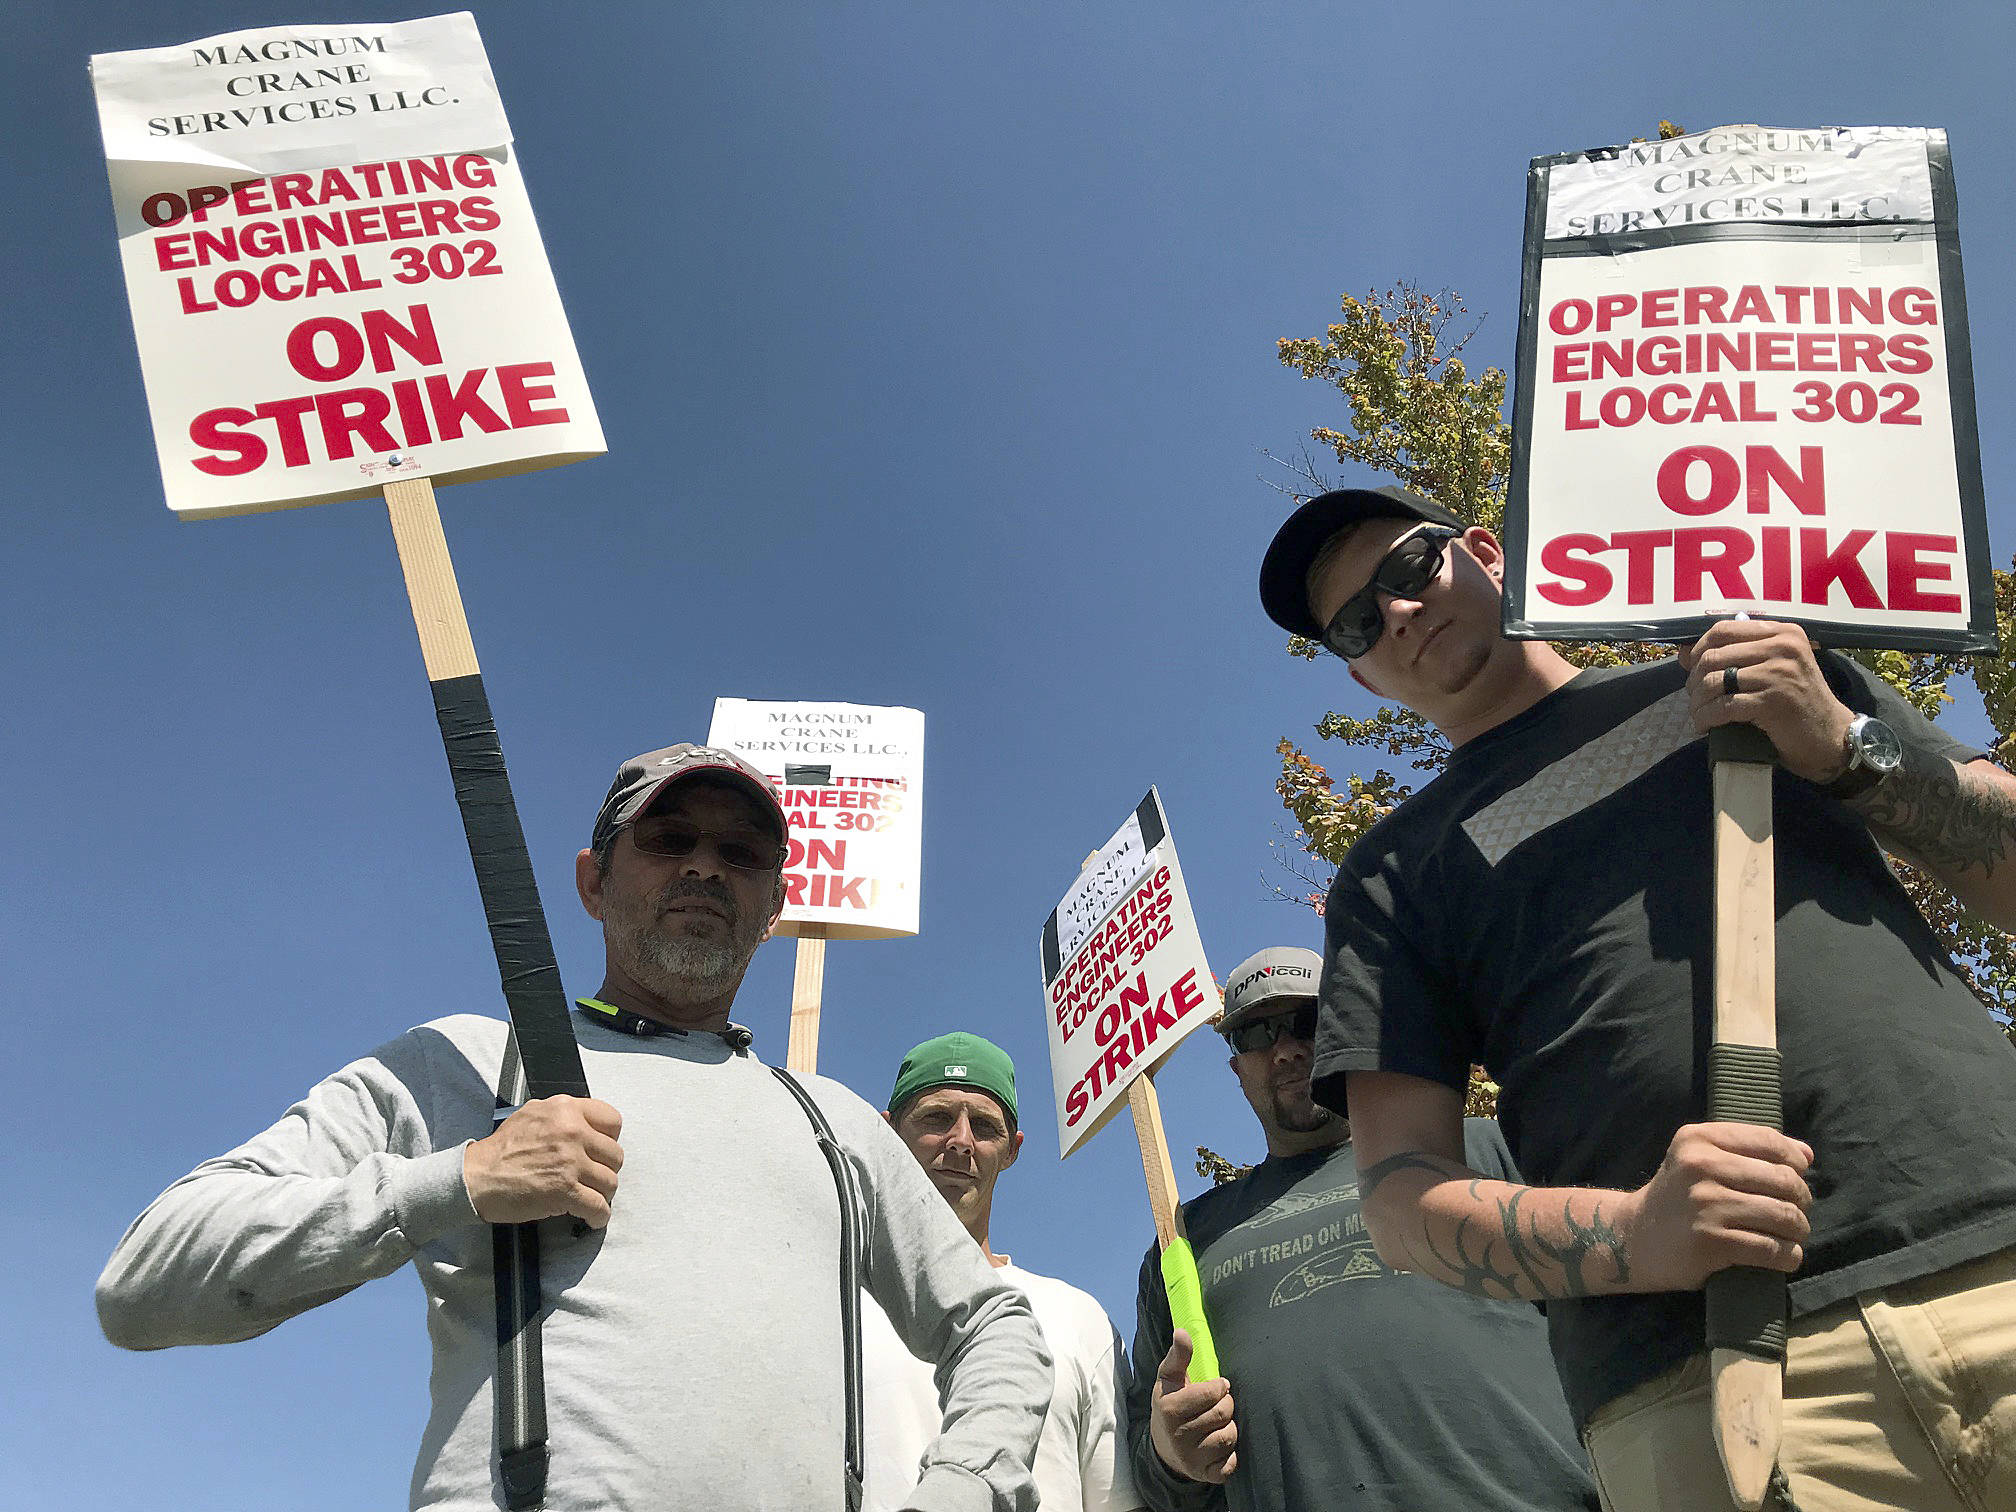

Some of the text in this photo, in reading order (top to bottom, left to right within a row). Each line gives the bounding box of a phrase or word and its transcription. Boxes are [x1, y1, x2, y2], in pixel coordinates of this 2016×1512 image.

[193, 36, 385, 67] MAGNUM
[227, 64, 370, 96] CRANE
[149, 86, 460, 136] SERVICES LLC.
[1627, 132, 1834, 167] MAGNUM
[1654, 164, 1808, 194] CRANE
[142, 154, 497, 228] OPERATING
[1568, 197, 1900, 237] SERVICES LLC.
[154, 196, 501, 272] ENGINEERS
[177, 240, 503, 314] LOCAL 302
[287, 304, 443, 382] ON
[1549, 285, 1938, 336] OPERATING
[1552, 332, 1934, 383] ENGINEERS
[189, 361, 570, 476] STRIKE
[1565, 381, 1922, 431] LOCAL 302
[1657, 445, 1826, 516] ON
[1536, 526, 1962, 613] STRIKE
[734, 740, 845, 754] SERVICES
[768, 713, 872, 725] MAGNUM
[781, 727, 858, 739] CRANE
[776, 789, 902, 813] INEERS
[1067, 841, 1130, 920] MAGNUM
[1076, 865, 1123, 923] CRANE
[1052, 866, 1171, 1004] OPERATING
[1061, 887, 1119, 961] ERVICES
[1056, 889, 1173, 1026] ENGINEERS
[1062, 914, 1174, 1045] LOCAL 302
[1094, 971, 1150, 1047] ON
[1065, 967, 1205, 1127] STRIKE
[1213, 1249, 1257, 1286] DON'T
[1261, 1234, 1314, 1264] TREAD
[1318, 1221, 1341, 1246] ON
